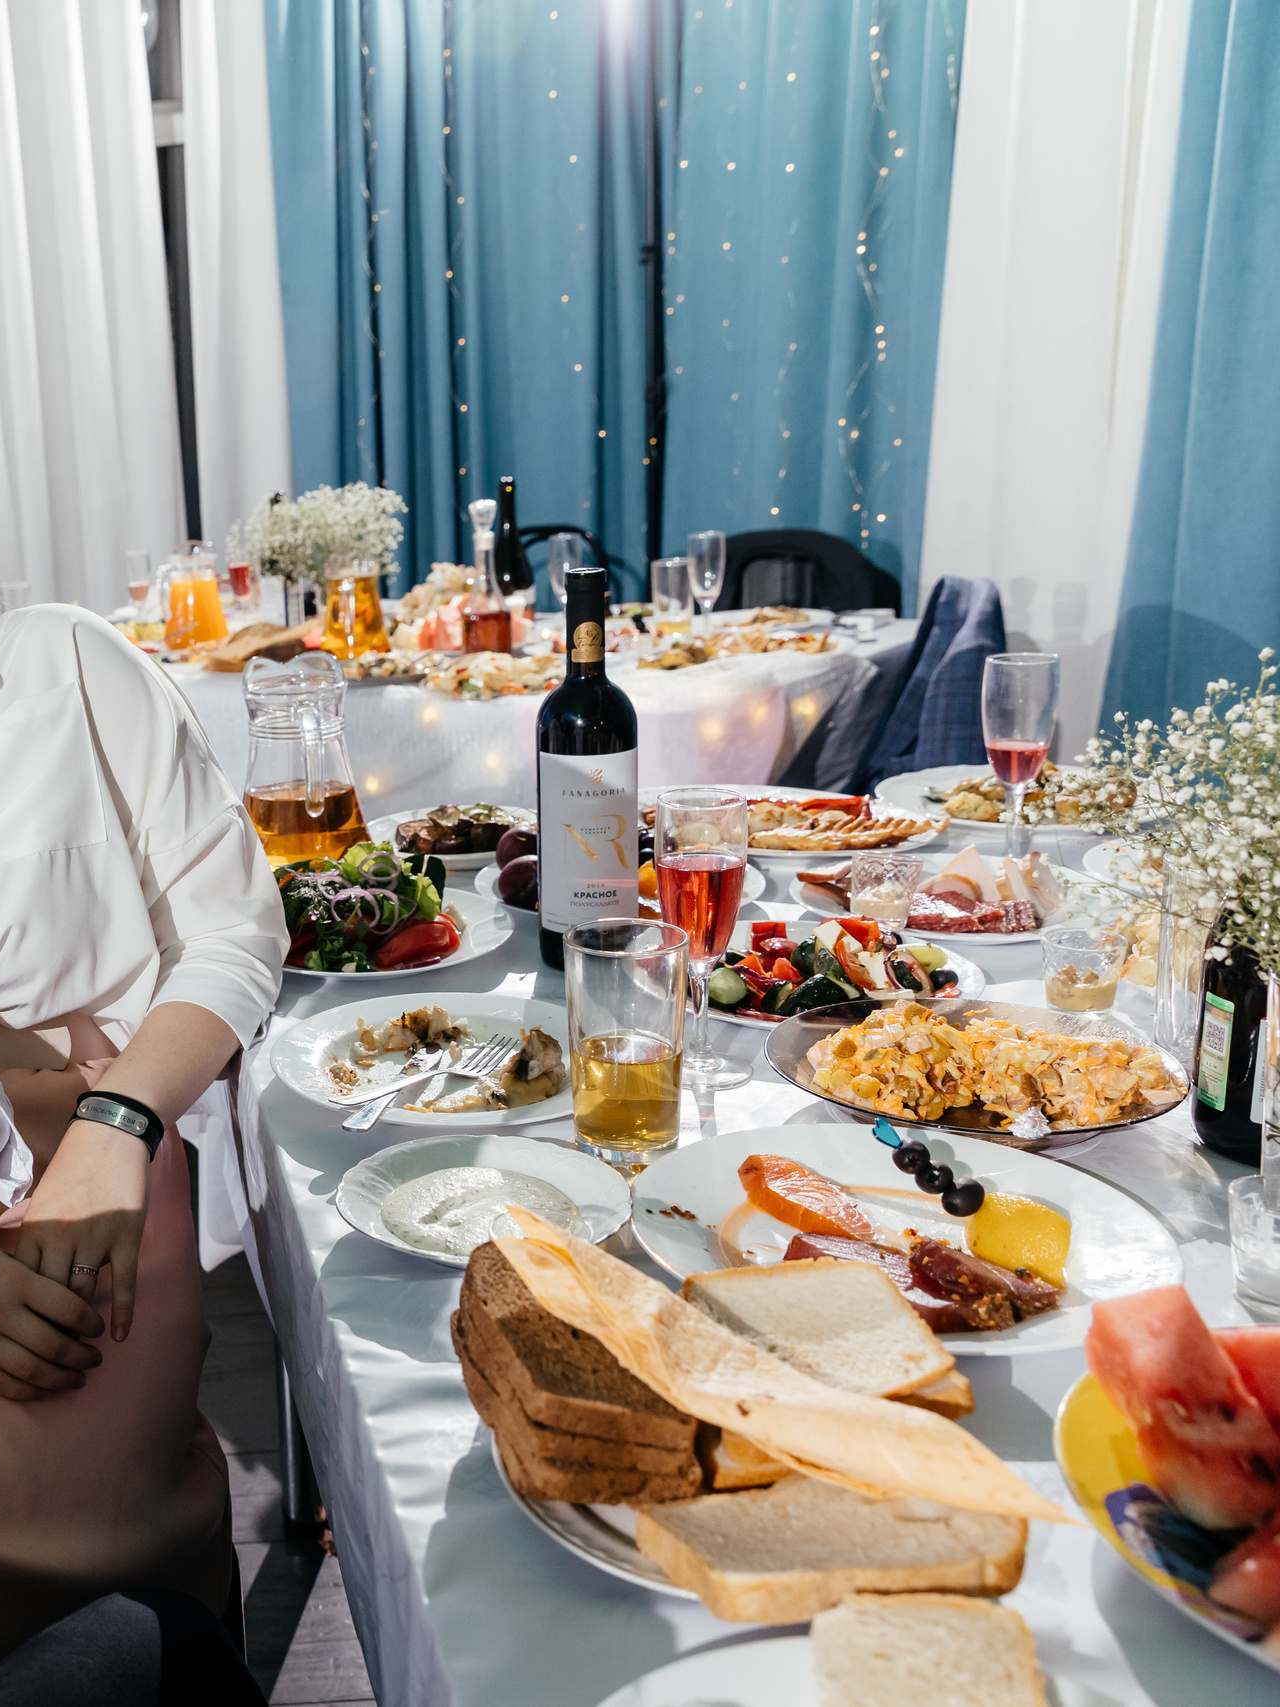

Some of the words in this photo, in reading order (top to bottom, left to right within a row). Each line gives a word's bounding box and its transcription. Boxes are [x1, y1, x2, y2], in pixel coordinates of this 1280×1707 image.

[562, 787, 625, 797] FANAGORIA
[573, 890, 618, 899] КРАСНОЕ
[89, 1106, 118, 1118] ЛЮБЛЮ
[119, 1114, 136, 1126] ТЕБЯ
